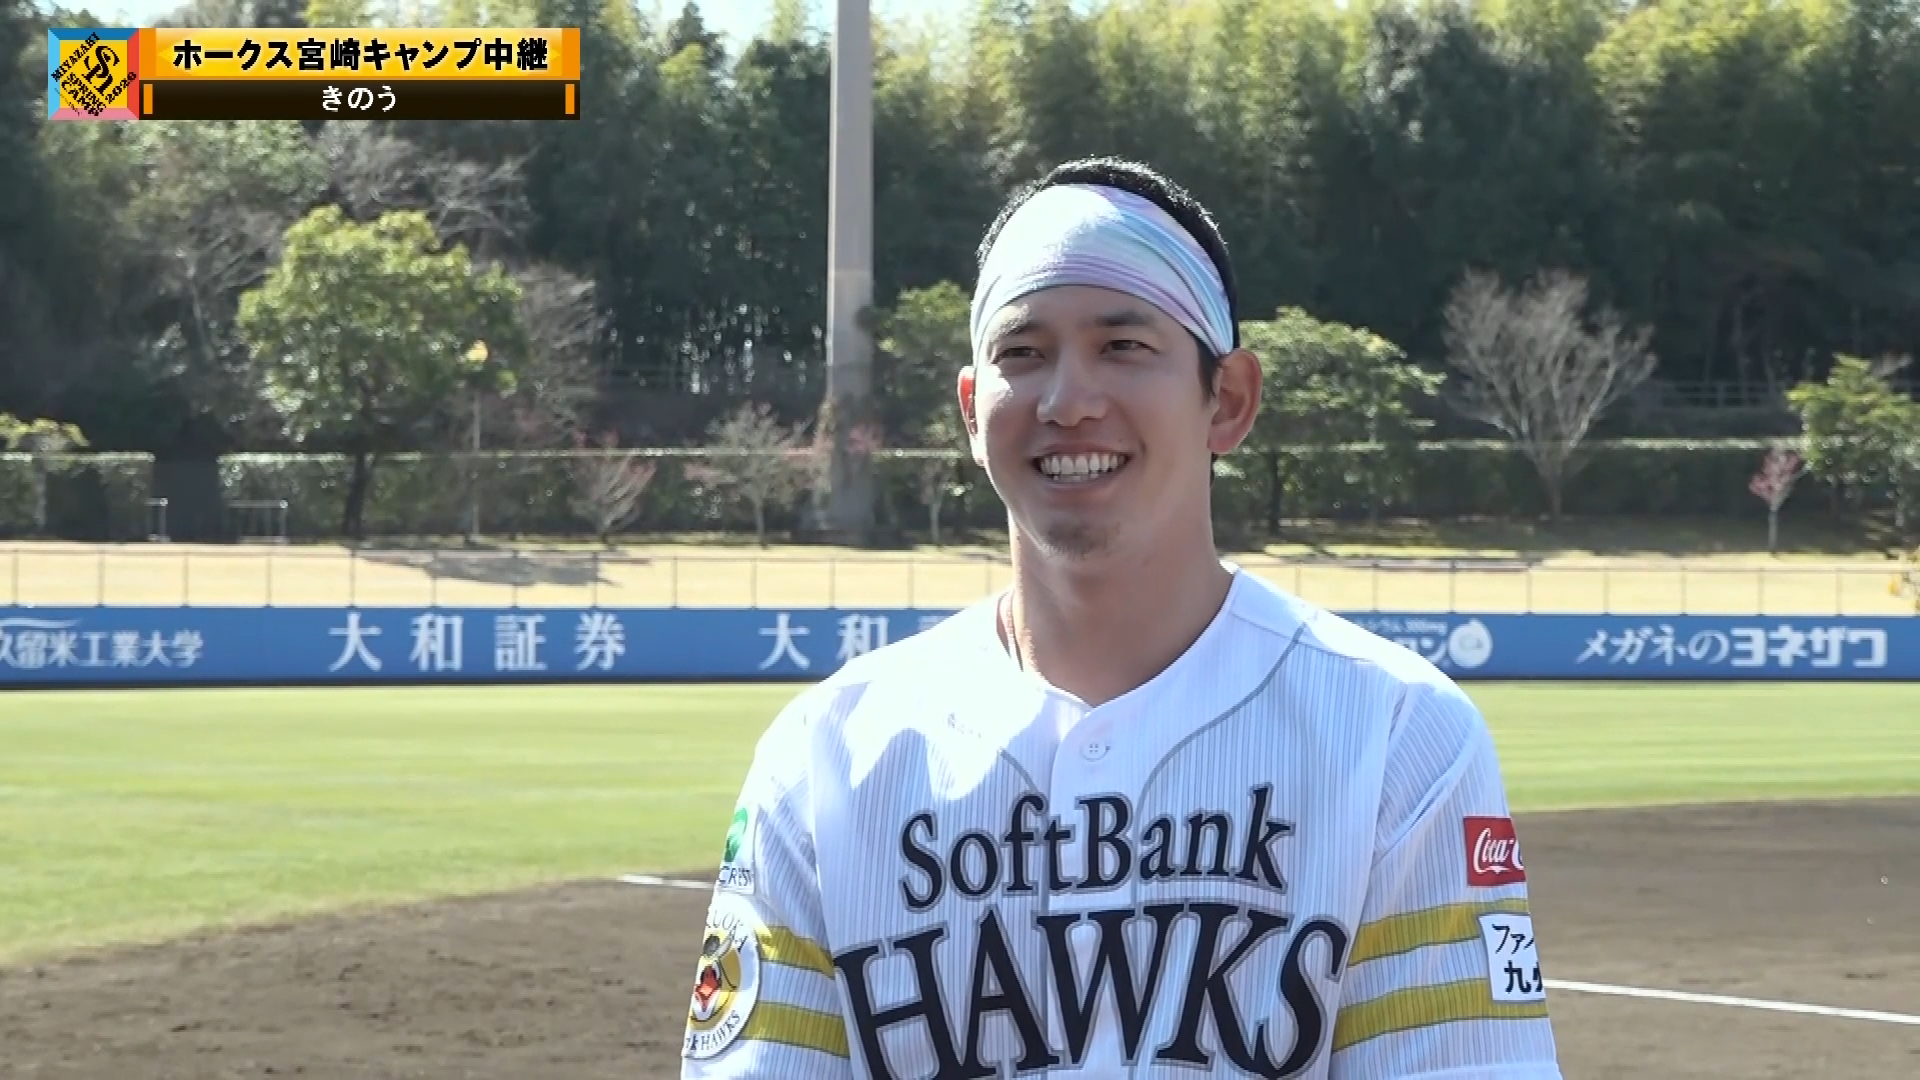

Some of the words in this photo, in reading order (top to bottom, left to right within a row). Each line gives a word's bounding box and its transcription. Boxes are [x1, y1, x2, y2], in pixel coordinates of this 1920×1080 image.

[328, 611, 626, 672] 大和証券
[900, 782, 1295, 912] SoftBank
[832, 897, 1350, 1080] HAWKS
